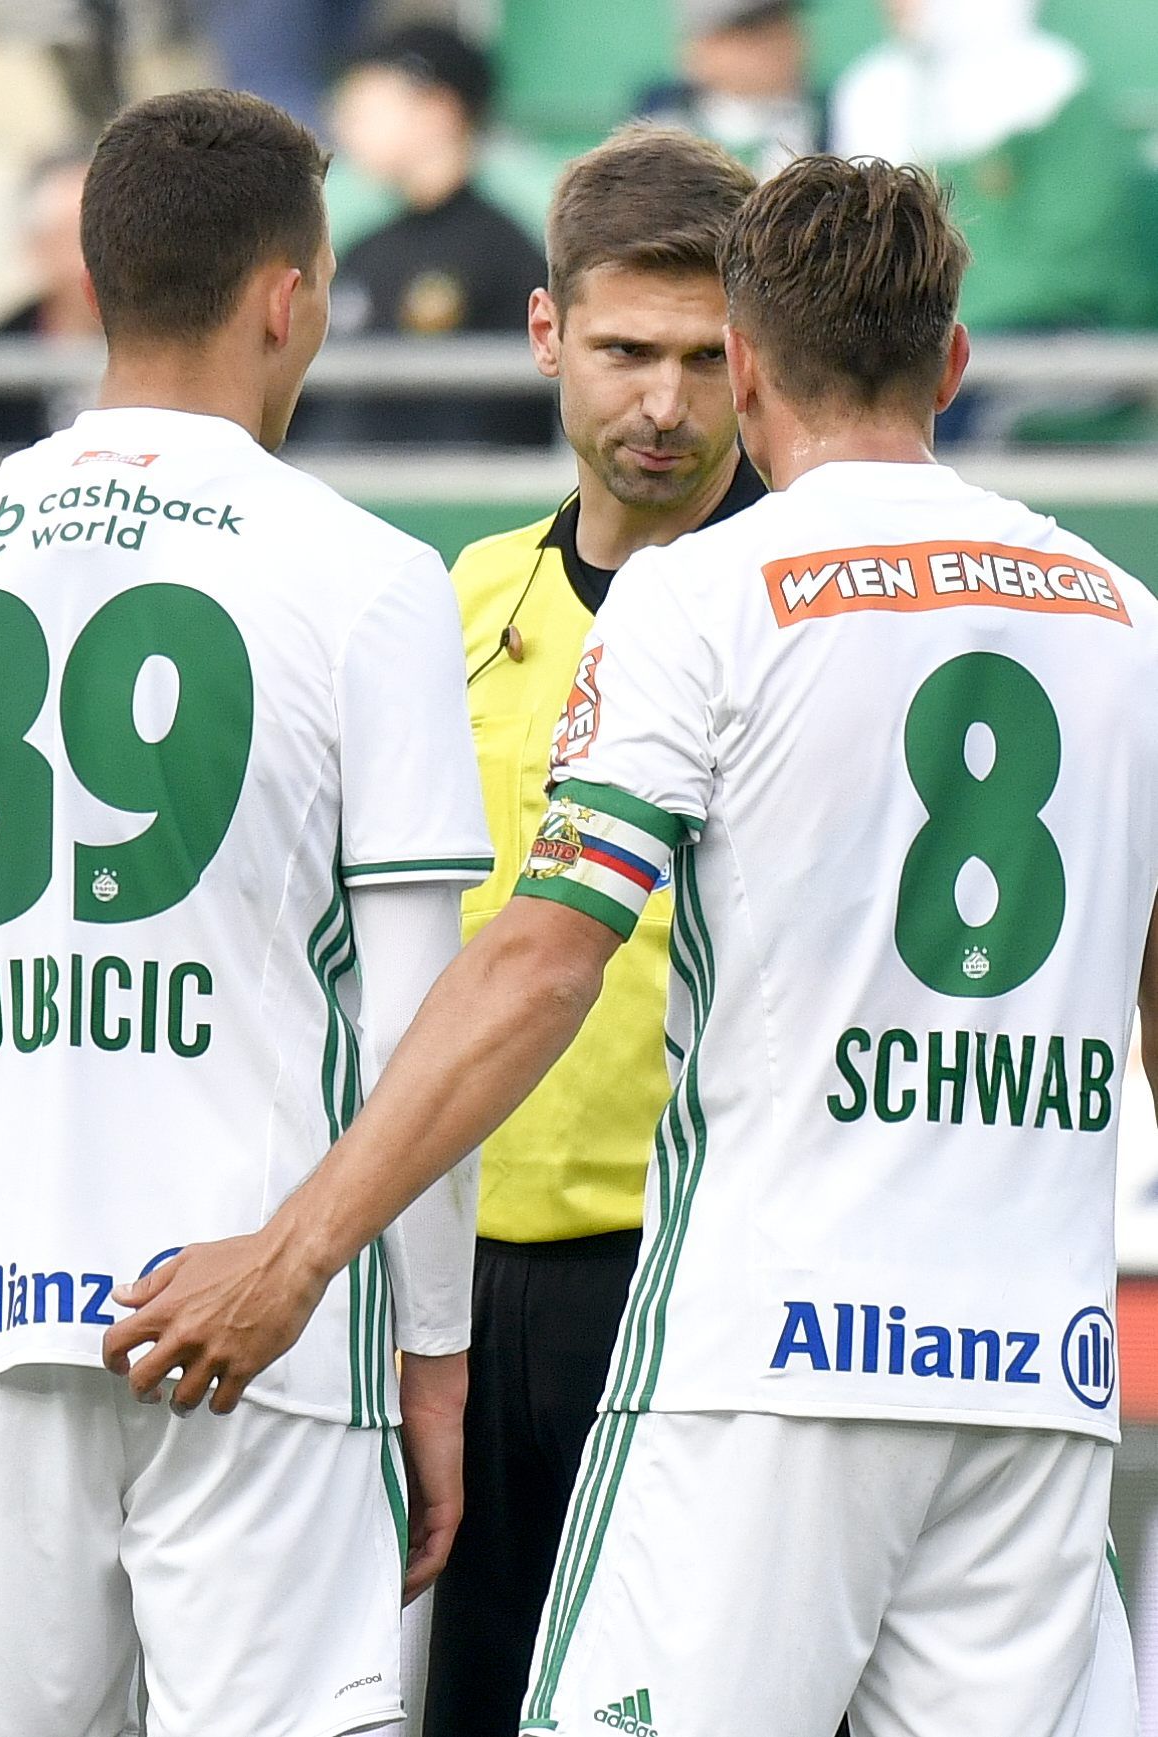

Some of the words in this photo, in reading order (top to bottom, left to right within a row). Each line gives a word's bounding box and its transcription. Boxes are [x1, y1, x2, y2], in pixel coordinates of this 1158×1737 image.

[31, 515, 147, 550] world
[39, 479, 244, 535] cashback
[779, 558, 918, 615] WIEN
[927, 551, 1120, 611] ENERGIE
[895, 651, 1066, 998] 8
[826, 1027, 1114, 1133] SCHWAB
[769, 1300, 1040, 1383] Allianz
